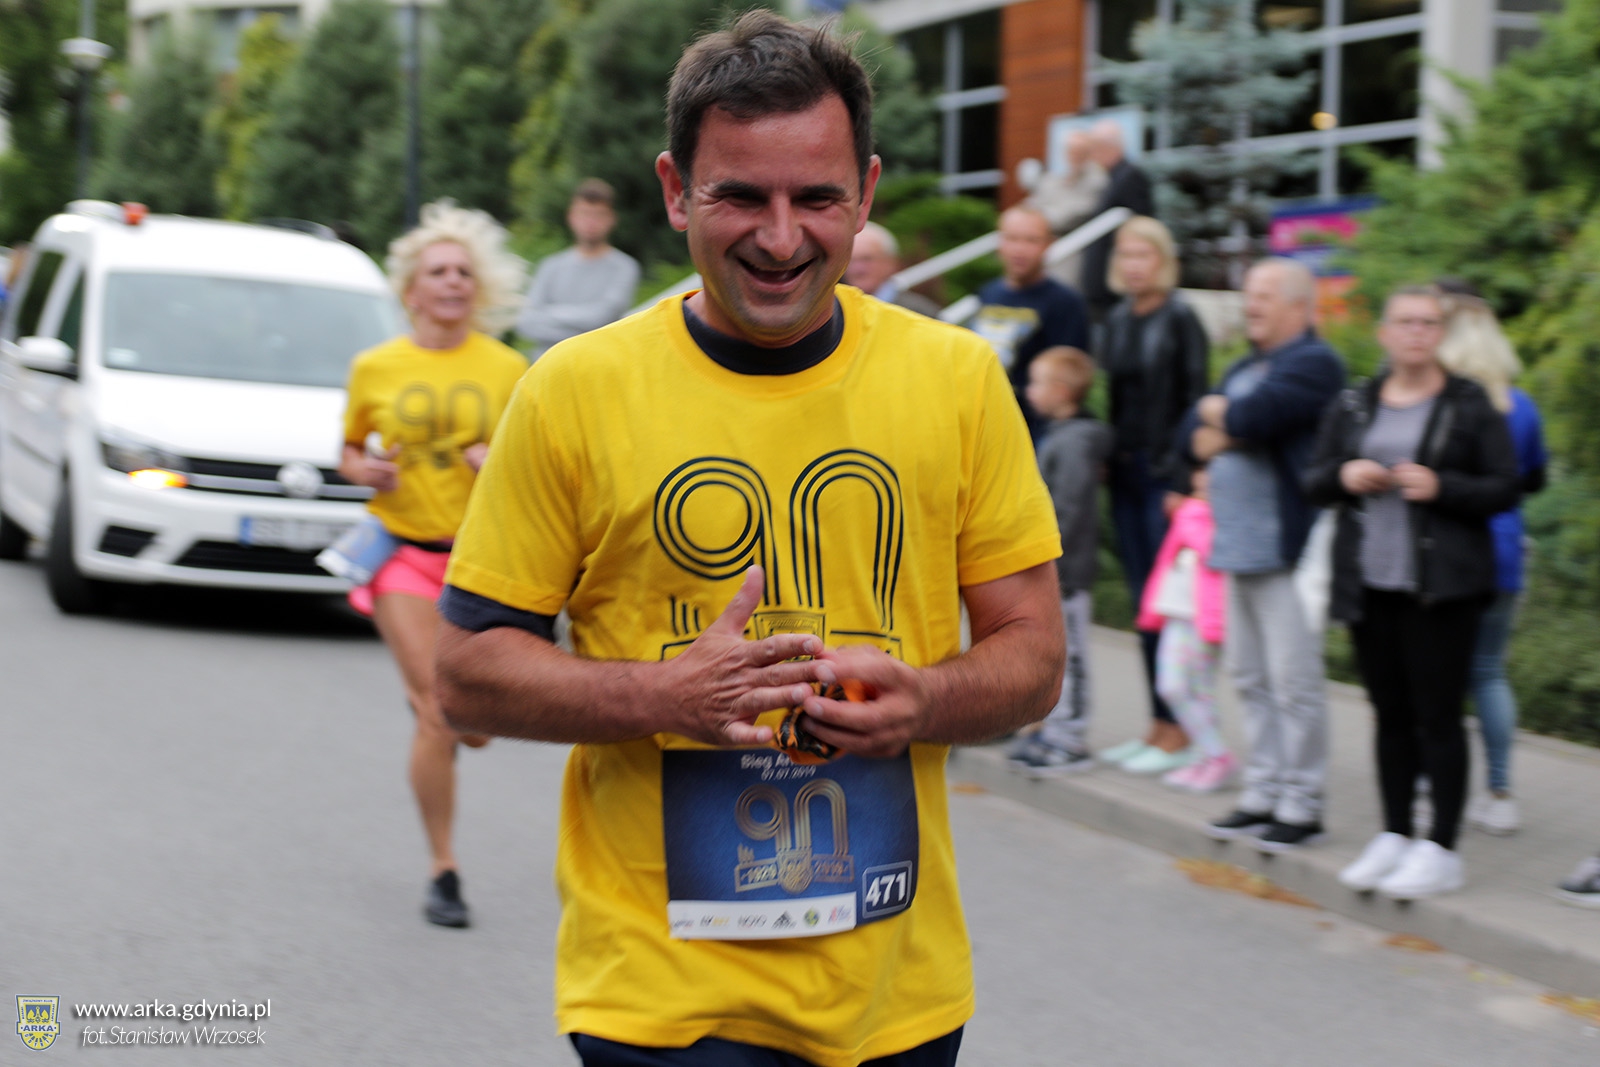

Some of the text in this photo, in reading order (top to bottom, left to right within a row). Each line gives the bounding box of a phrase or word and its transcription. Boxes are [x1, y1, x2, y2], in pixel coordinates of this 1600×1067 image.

[654, 448, 904, 631] 90
[735, 778, 849, 857] 90
[866, 872, 907, 907] 471
